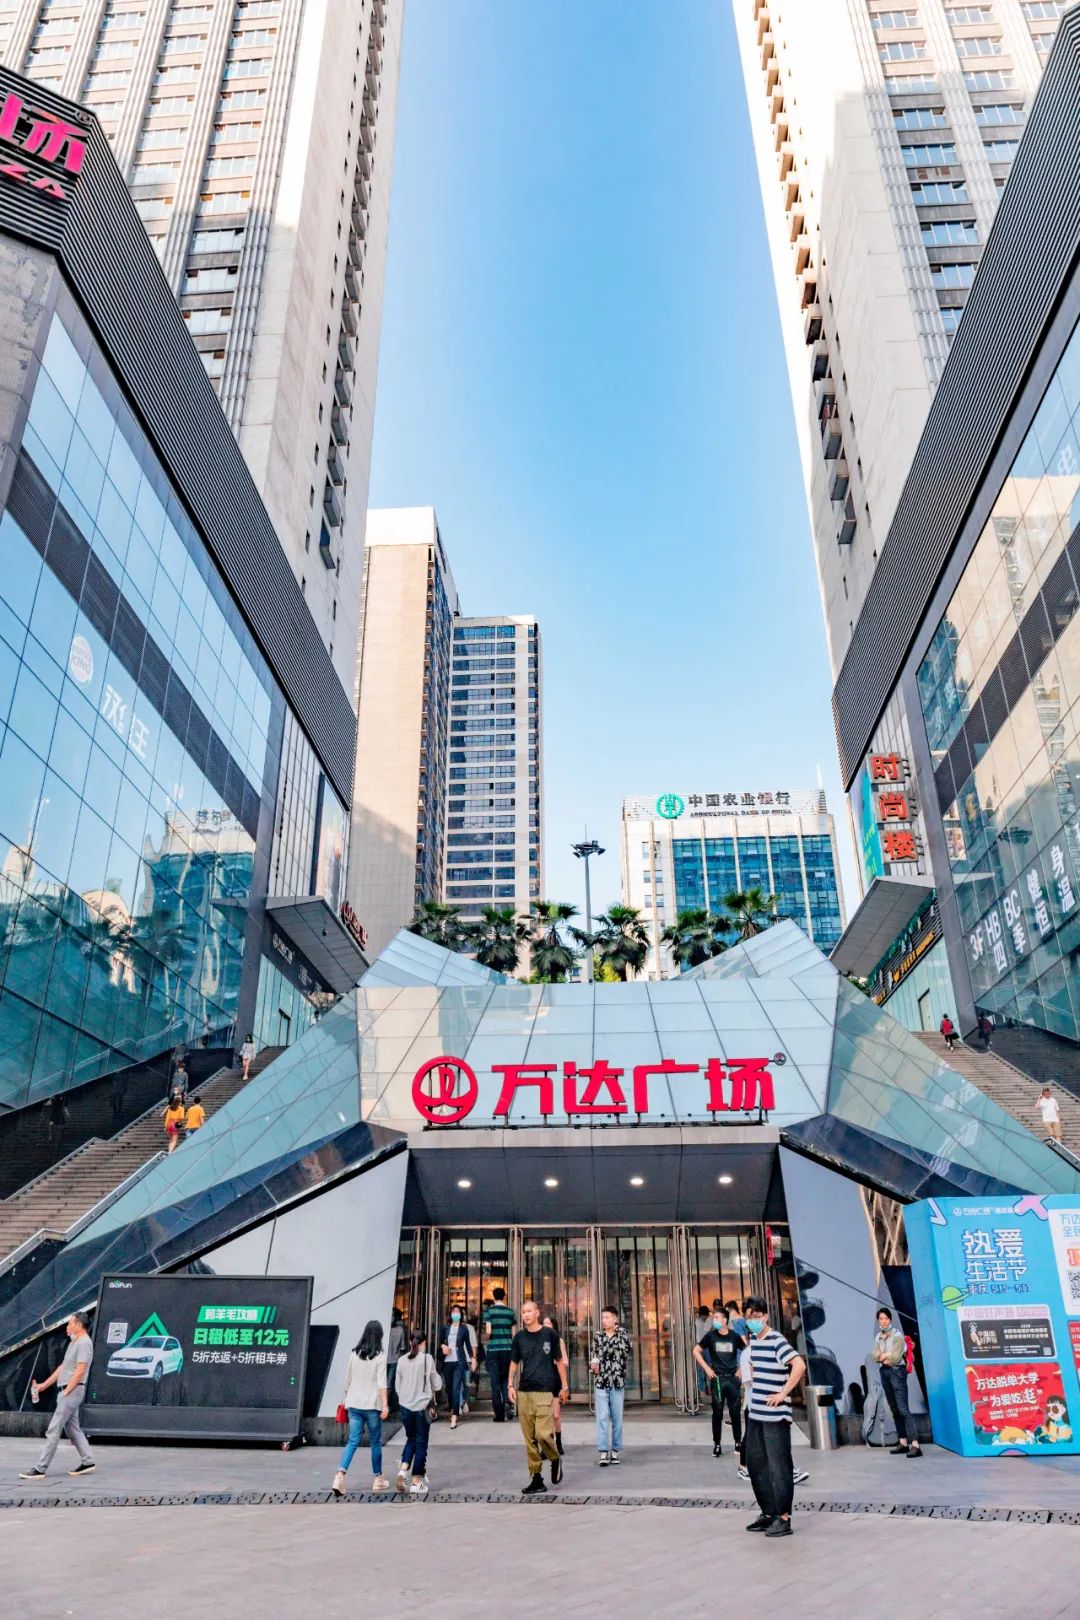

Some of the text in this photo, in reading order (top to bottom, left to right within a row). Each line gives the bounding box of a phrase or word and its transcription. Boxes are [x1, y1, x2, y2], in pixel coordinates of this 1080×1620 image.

[688, 791, 790, 807] 中国农业银行
[870, 753, 915, 860] 时尚楼
[993, 875, 1076, 974] 四季恒温
[491, 1057, 776, 1116] 万达广场
[963, 1228, 1025, 1259] 热爱
[965, 1259, 1027, 1282] 生活节
[193, 1327, 289, 1346] 日租低至12元
[191, 1350, 288, 1365] 5折充返+5折租车券
[975, 1372, 1040, 1391] 万达脱单大学
